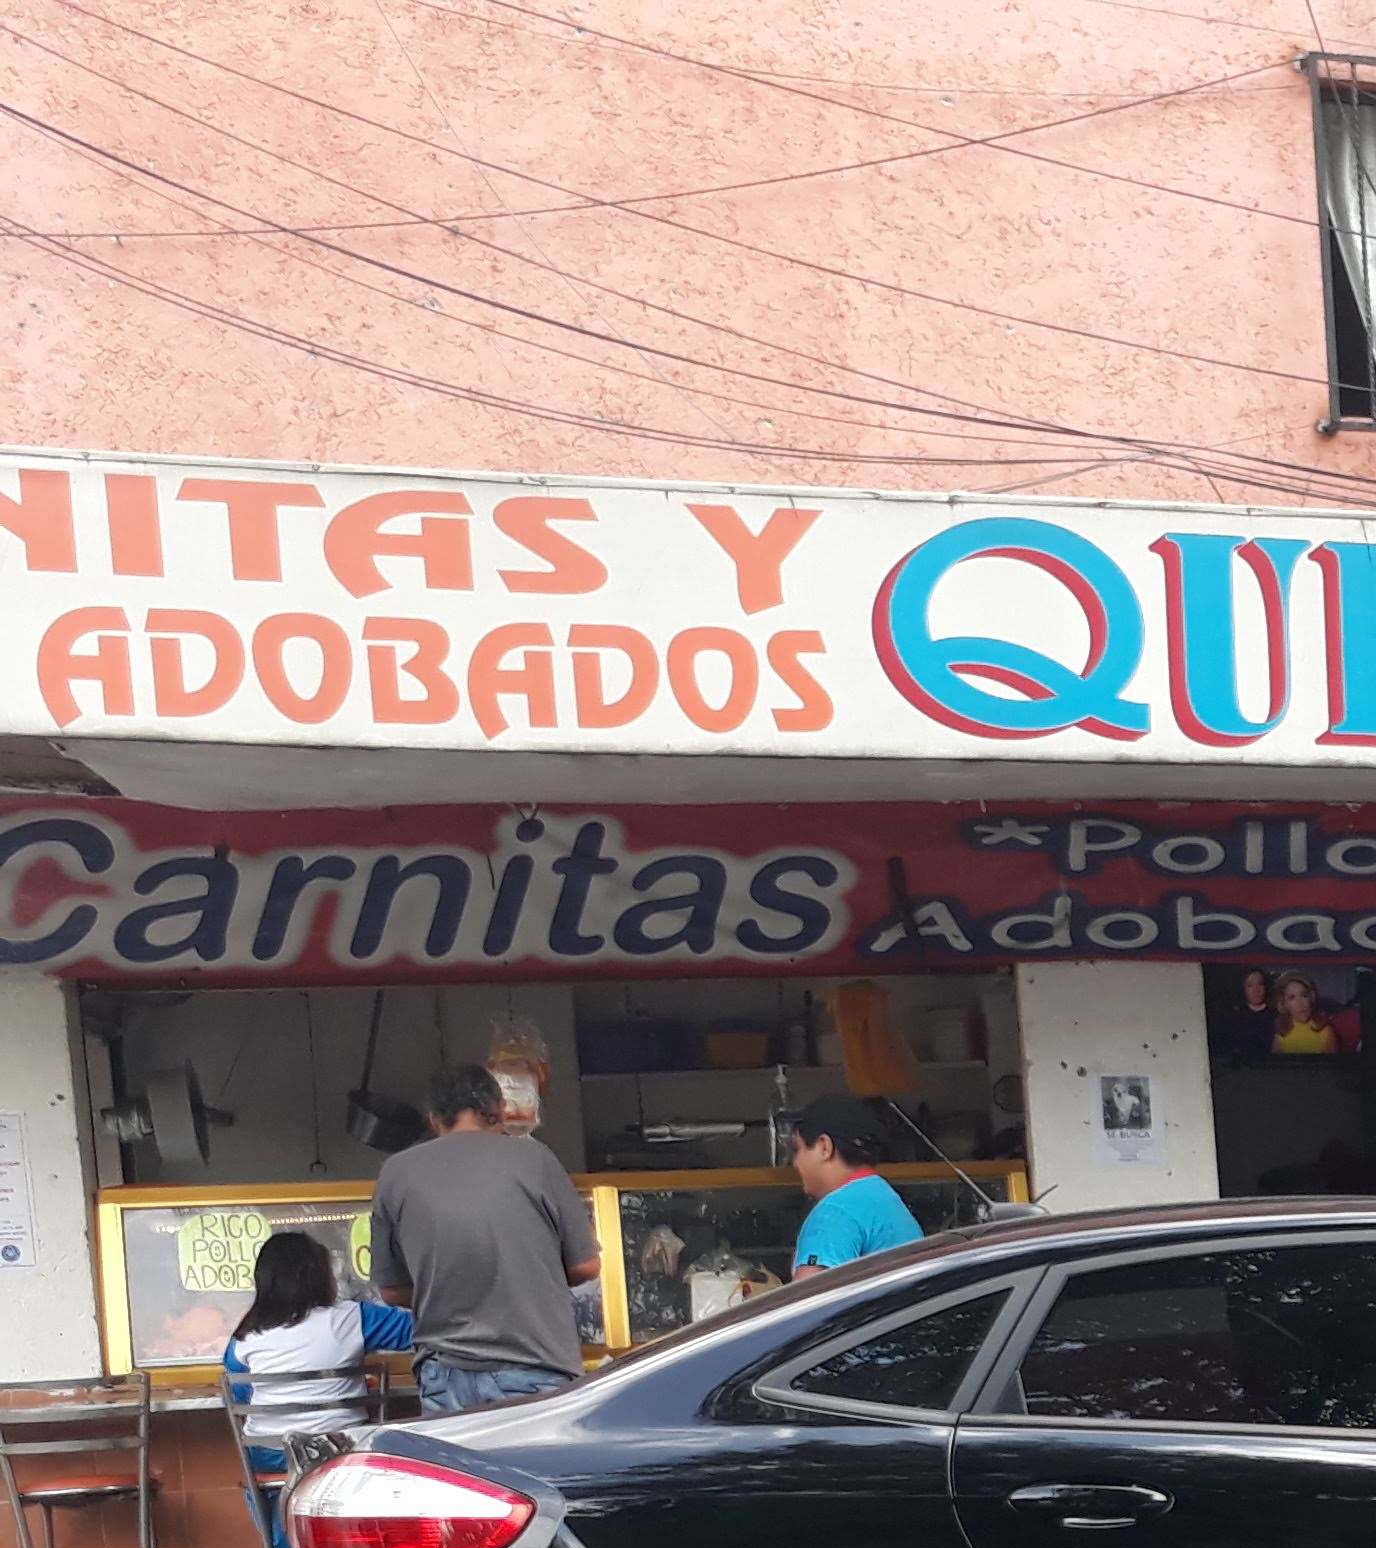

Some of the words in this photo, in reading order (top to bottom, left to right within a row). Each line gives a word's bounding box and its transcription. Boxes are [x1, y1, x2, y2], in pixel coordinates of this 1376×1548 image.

[686, 504, 823, 615] Y
[37, 606, 835, 741] ADOBADOS
[0, 817, 842, 965] Carnitas
[200, 1213, 262, 1239] RICO
